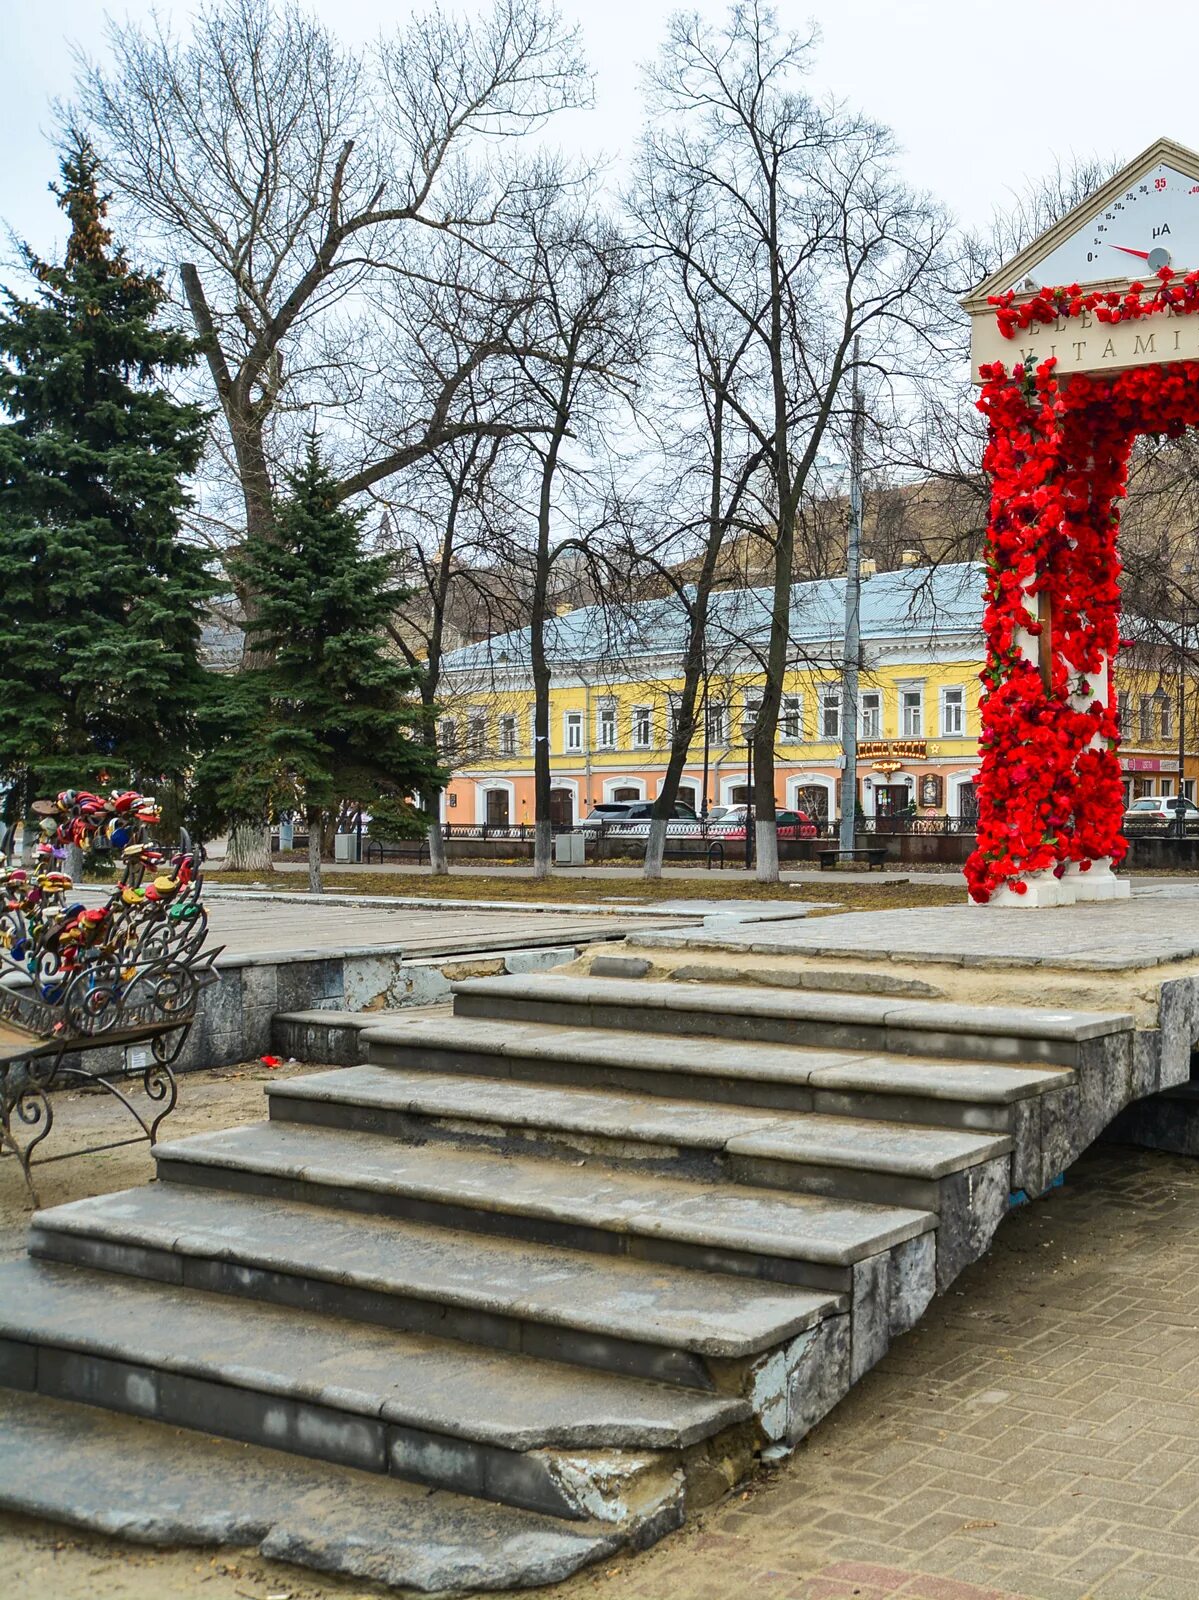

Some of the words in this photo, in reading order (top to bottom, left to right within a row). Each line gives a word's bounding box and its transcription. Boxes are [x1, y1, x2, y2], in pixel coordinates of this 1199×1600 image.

[1154, 178, 1167, 189] 35
[1139, 185, 1148, 193] 30
[1087, 253, 1093, 262] 0
